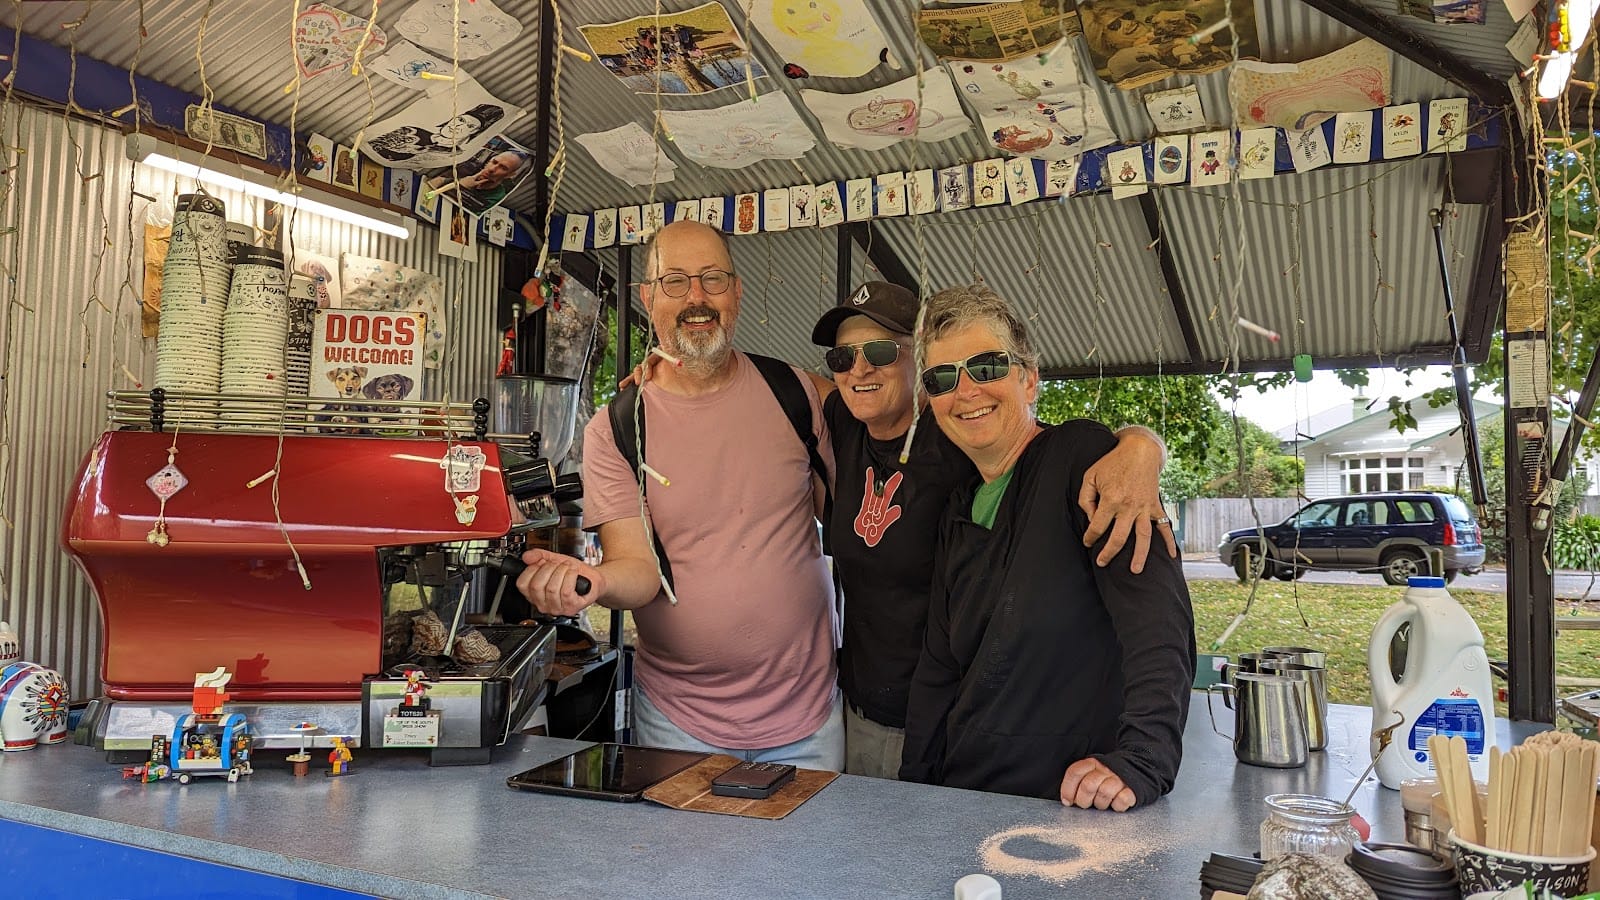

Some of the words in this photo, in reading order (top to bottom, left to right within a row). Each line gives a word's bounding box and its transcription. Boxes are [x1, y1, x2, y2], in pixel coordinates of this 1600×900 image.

[946, 6, 986, 16] Christmas
[987, 2, 1009, 13] party
[325, 313, 415, 346] DOGS
[324, 346, 414, 365] WELCOME!
